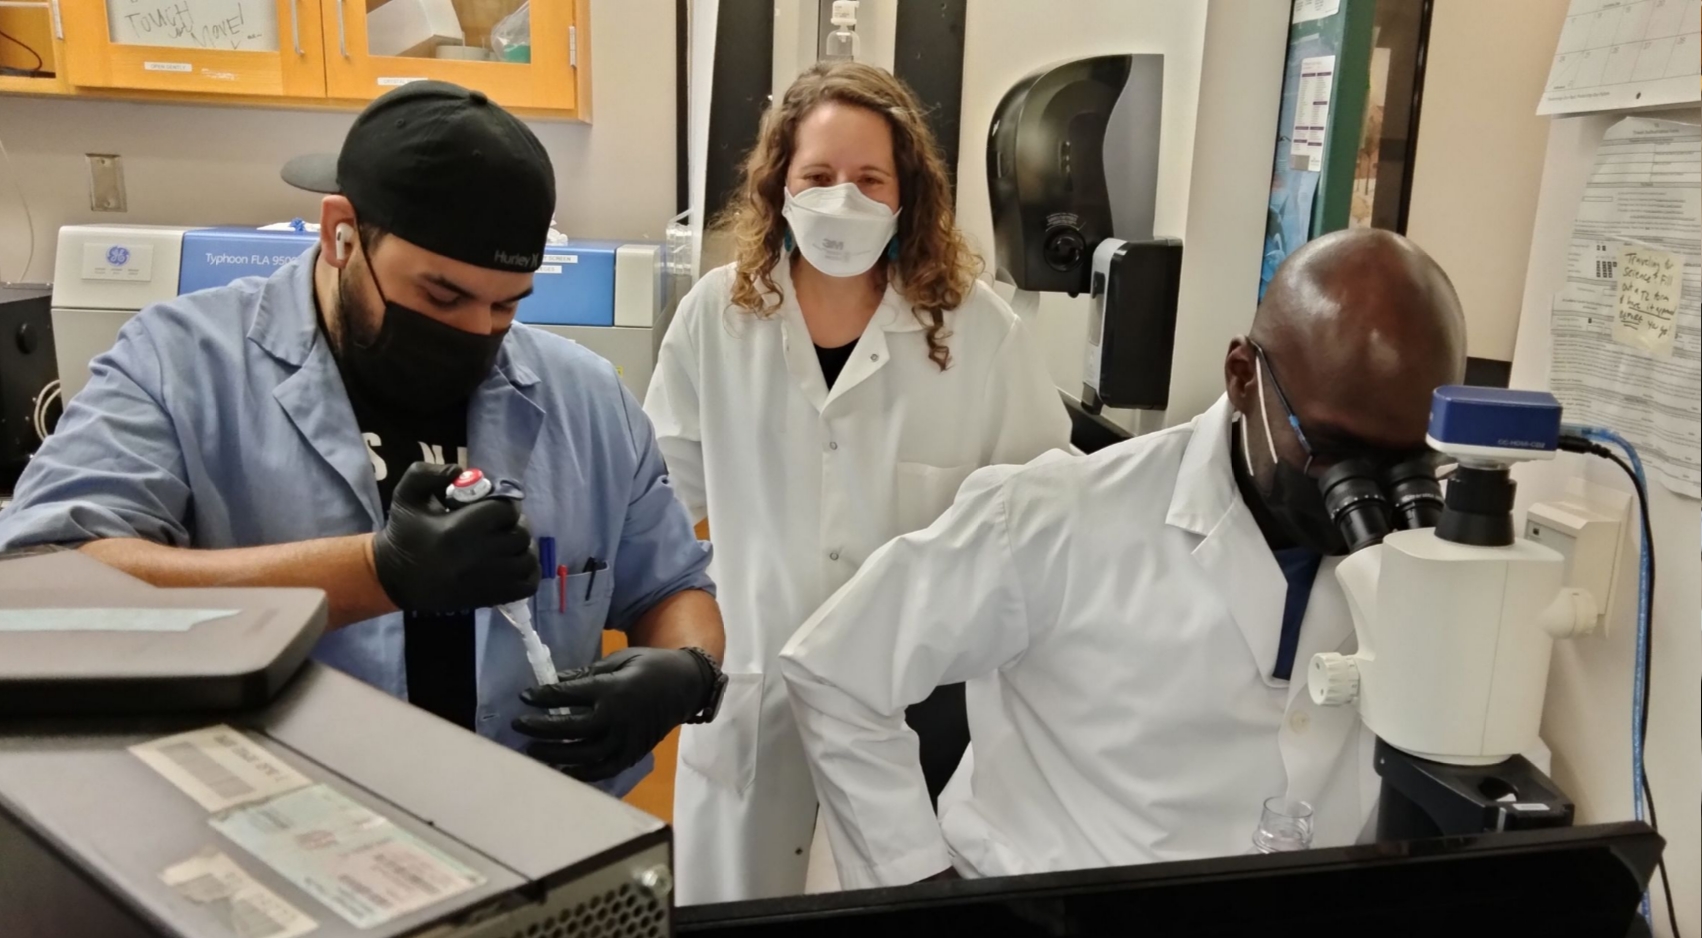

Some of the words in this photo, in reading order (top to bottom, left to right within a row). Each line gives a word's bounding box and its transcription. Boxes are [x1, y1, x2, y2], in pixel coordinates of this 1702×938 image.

[125, 1, 194, 38] TOUCH
[822, 238, 844, 250] 3M
[205, 252, 248, 266] Typhoon
[251, 254, 270, 265] FLA
[494, 250, 531, 267] Hurley
[1625, 253, 1660, 271] Traveling
[1622, 282, 1632, 291] out
[1660, 273, 1673, 286] Fill
